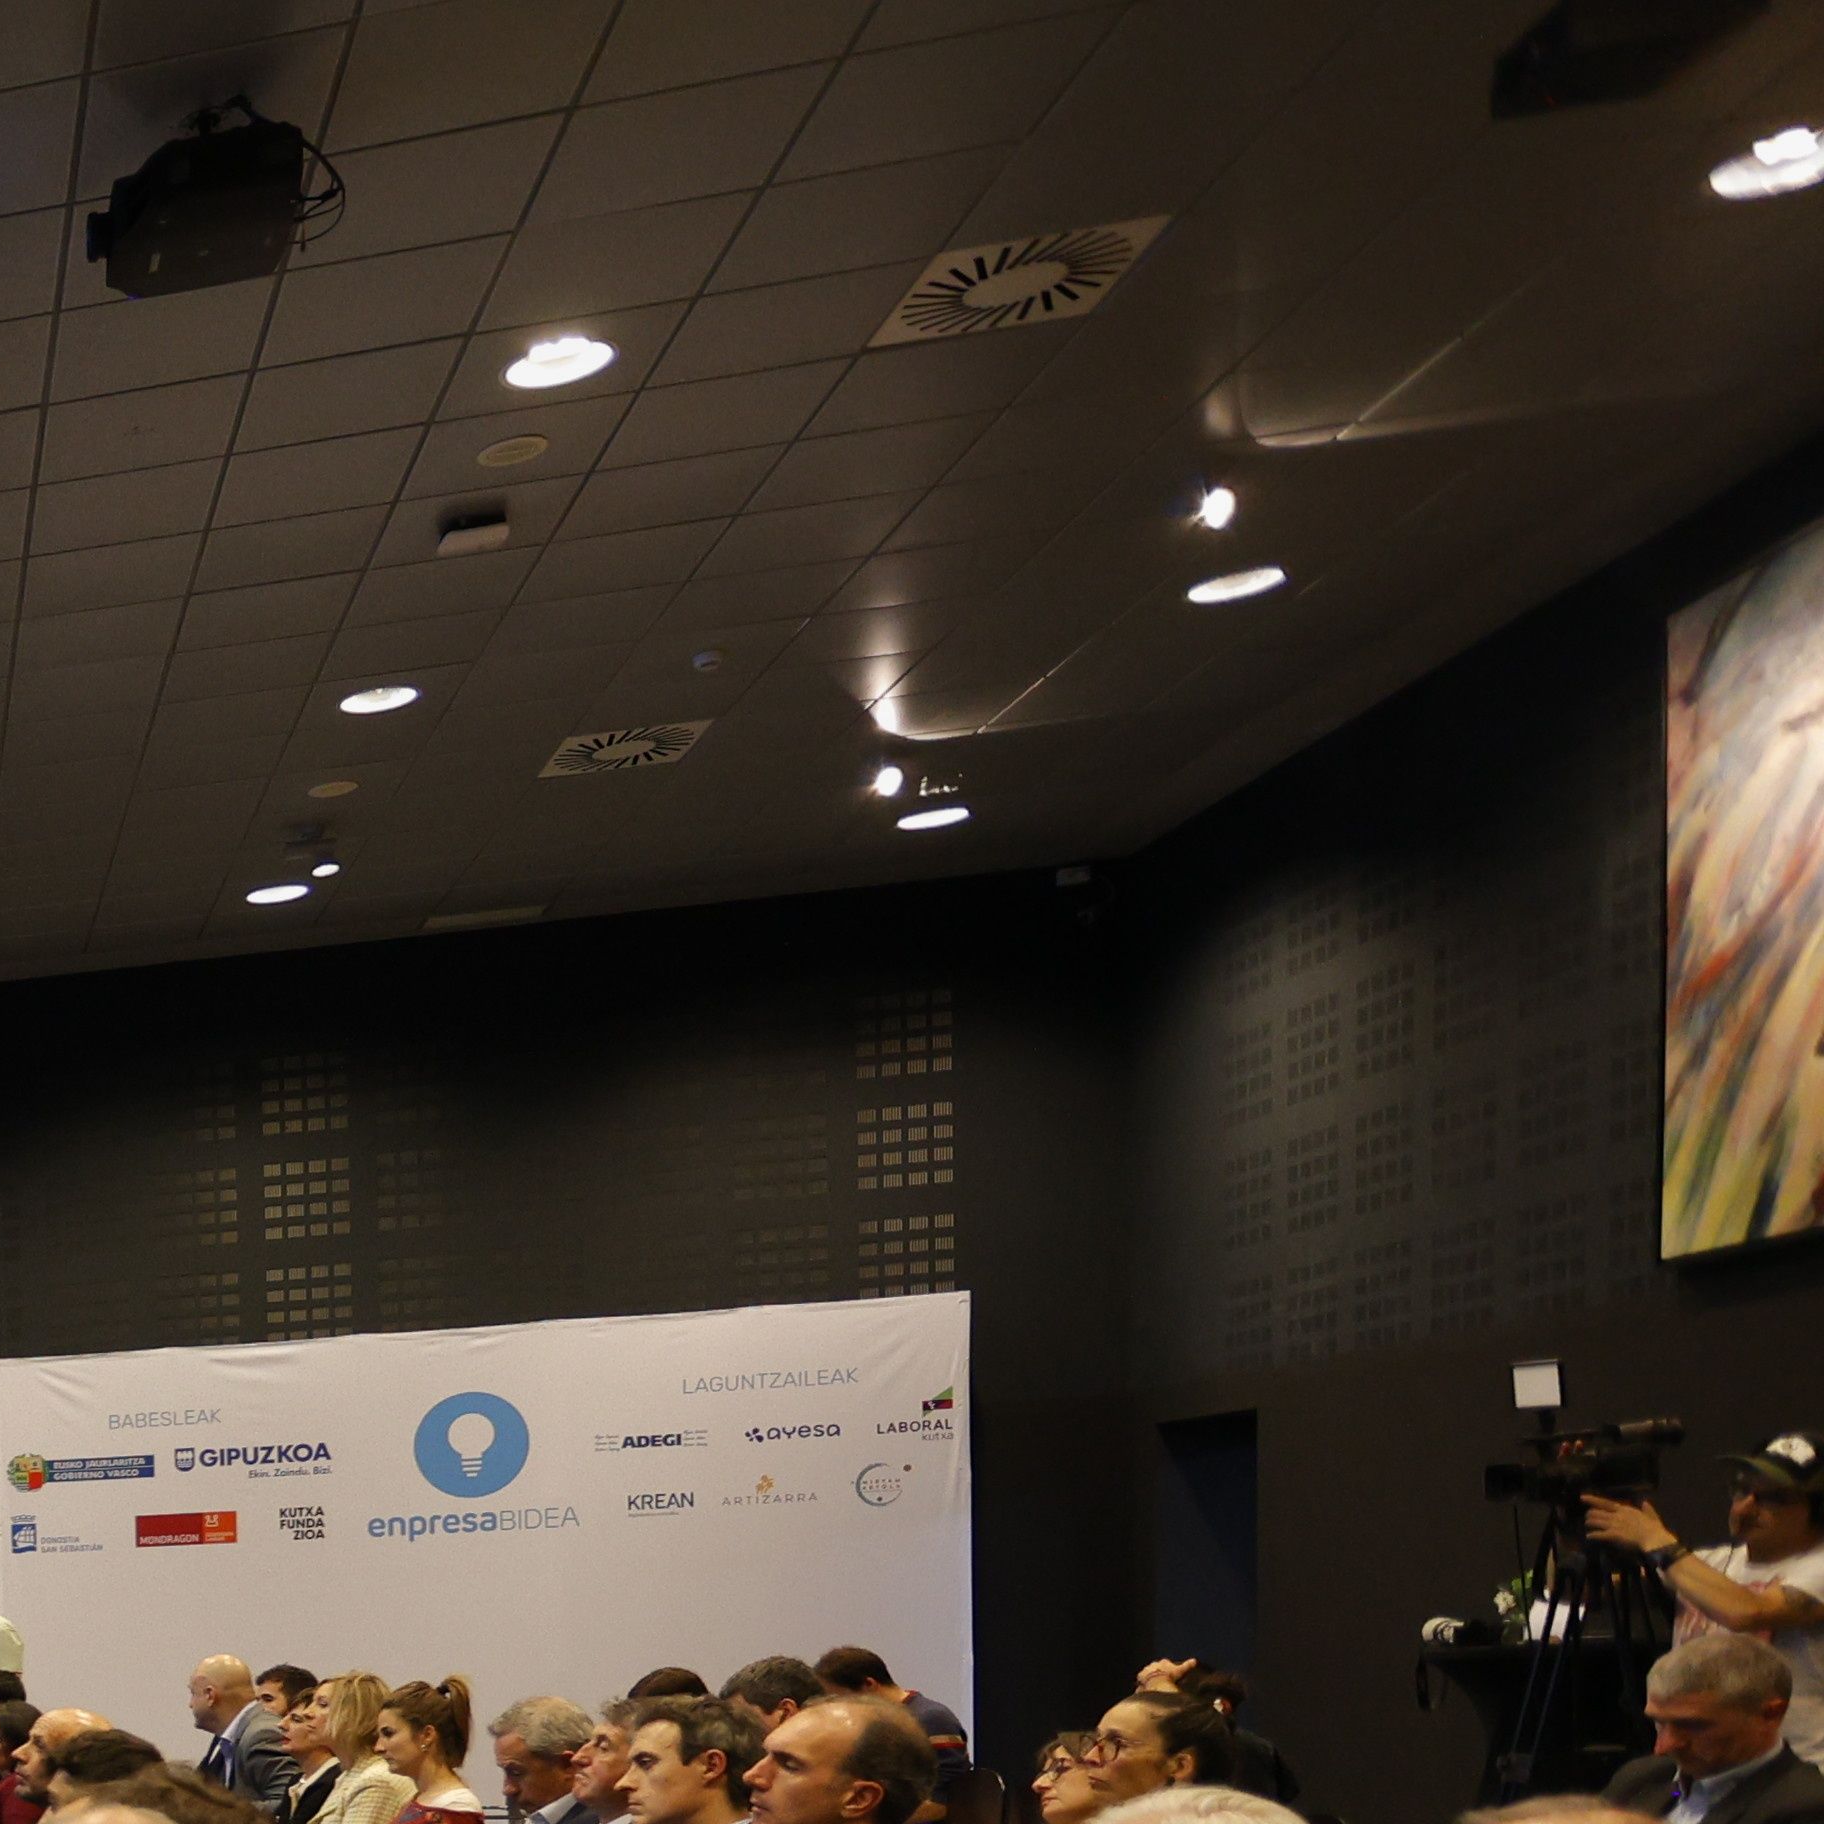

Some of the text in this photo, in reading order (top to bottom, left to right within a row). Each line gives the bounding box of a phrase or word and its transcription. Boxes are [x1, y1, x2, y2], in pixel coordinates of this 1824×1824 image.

[682, 1367, 859, 1395] LAGUNTZAILEAK
[108, 1408, 222, 1431] BABESLEAK
[876, 1418, 954, 1435] LABORAL
[766, 1423, 842, 1441] ayesa
[921, 1431, 955, 1442] kutxa
[621, 1433, 683, 1449] ADEGI
[198, 1442, 332, 1468] GIPUZKOA
[106, 1469, 140, 1478] VASCO
[627, 1491, 695, 1511] KREAN
[721, 1491, 819, 1506] ARTIZARRA
[279, 1505, 325, 1518] KUTXA
[279, 1517, 325, 1530] FUNDA
[367, 1506, 580, 1543] enpresaBIDEA
[139, 1533, 200, 1545] MONDRAGON
[293, 1529, 325, 1541] ZIOA
